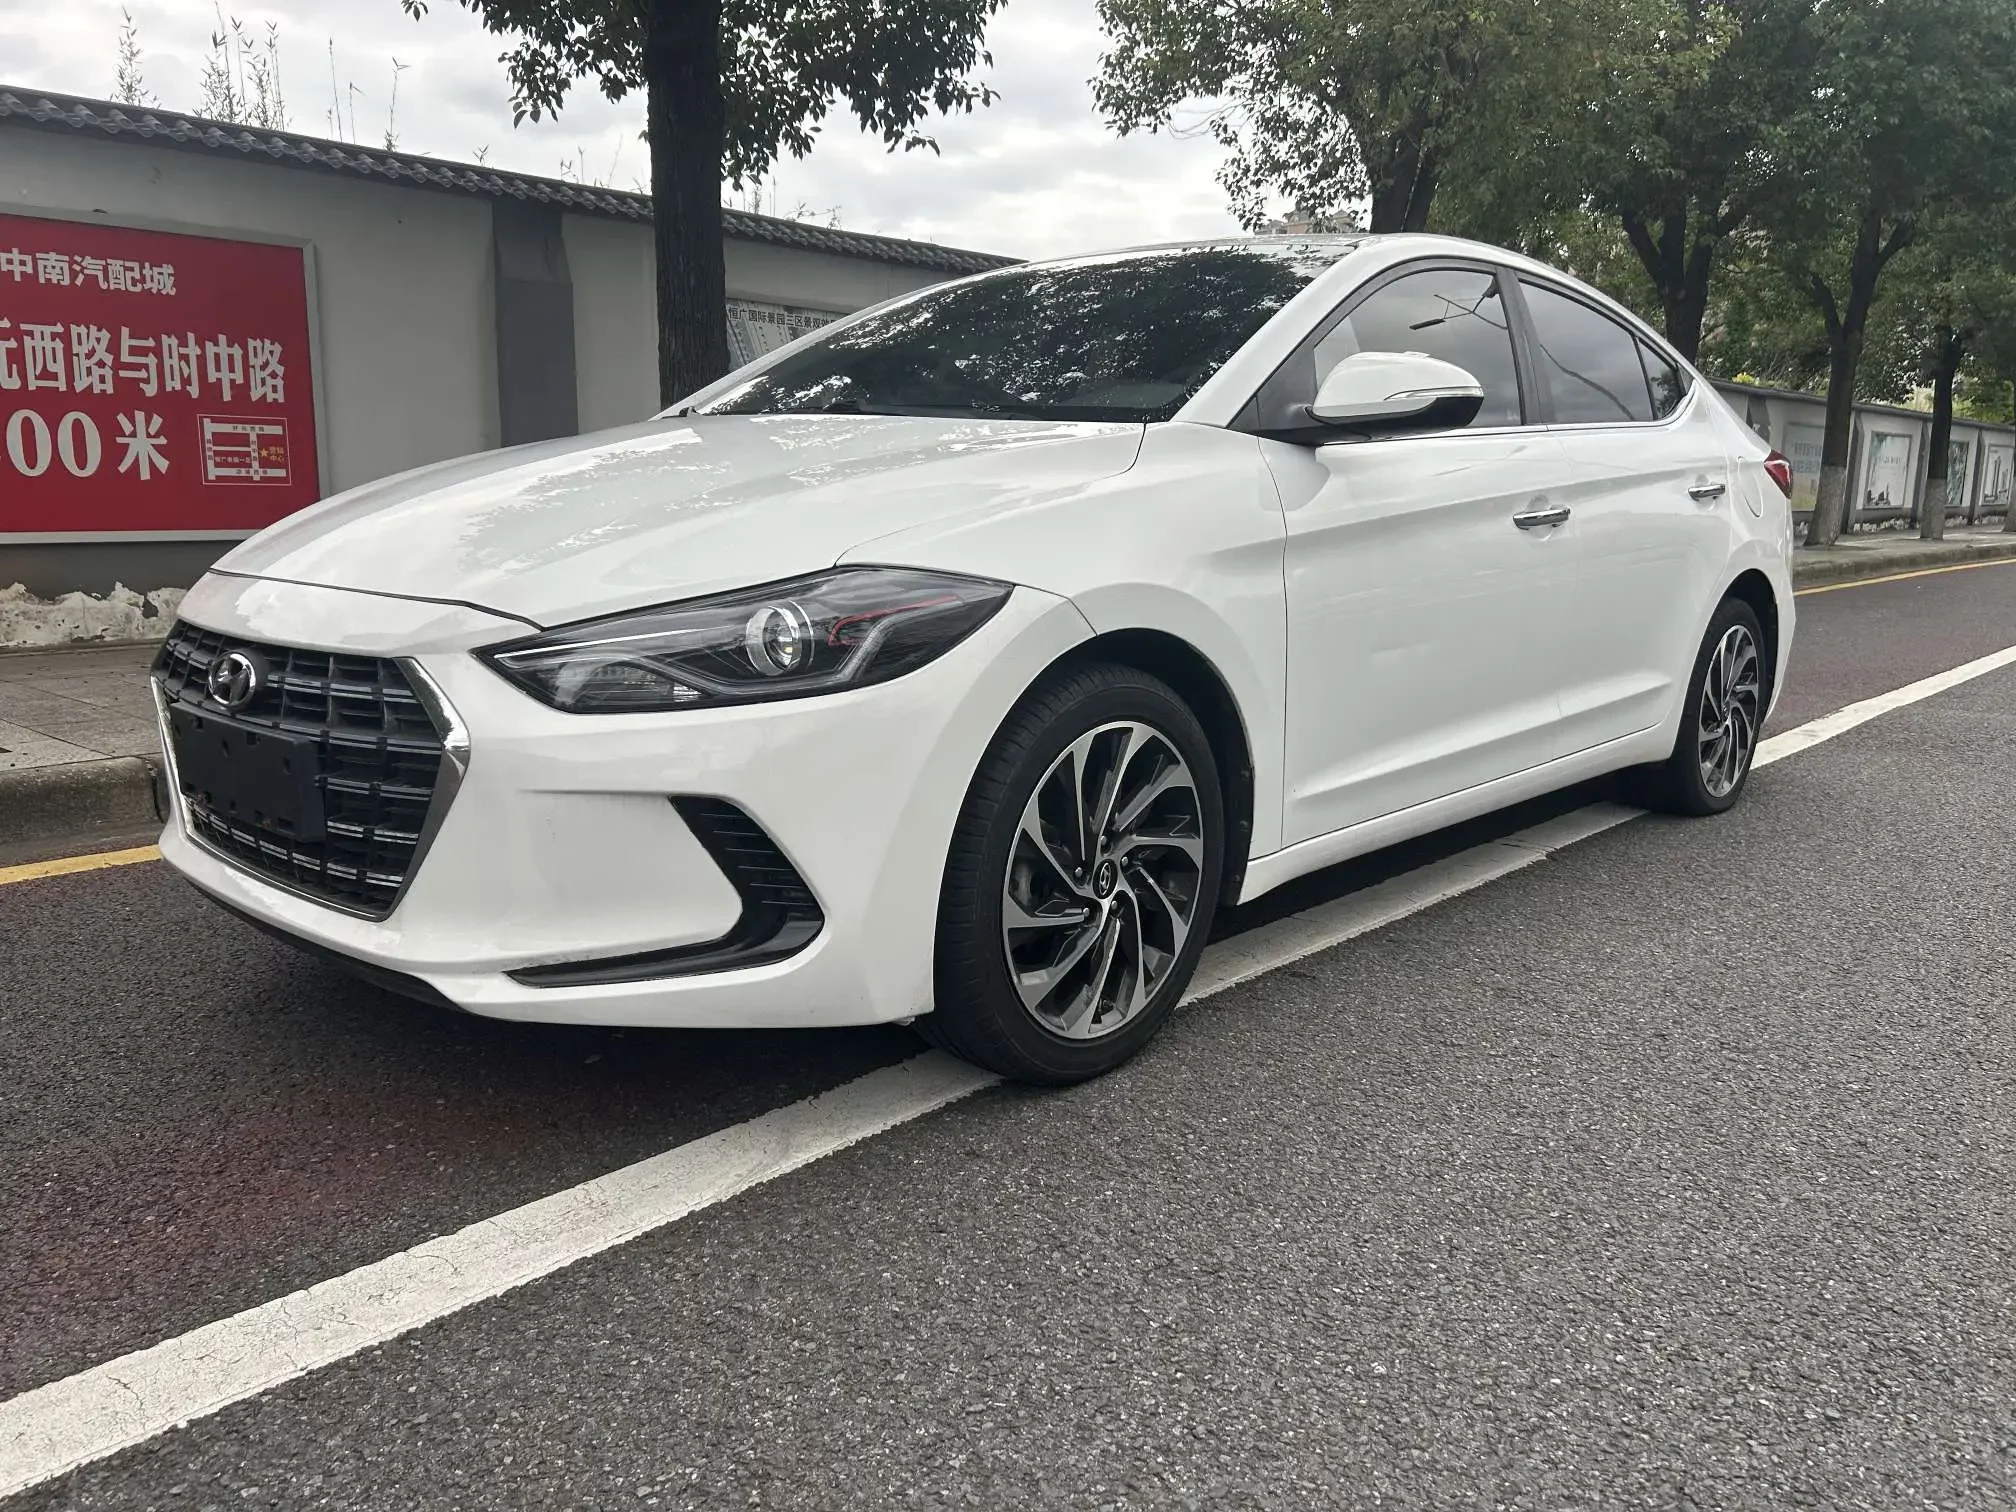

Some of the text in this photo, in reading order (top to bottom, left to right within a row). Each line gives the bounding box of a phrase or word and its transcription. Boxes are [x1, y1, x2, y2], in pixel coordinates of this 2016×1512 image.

[0, 248, 176, 295] 中南汽配城
[0, 409, 170, 481] 00米
